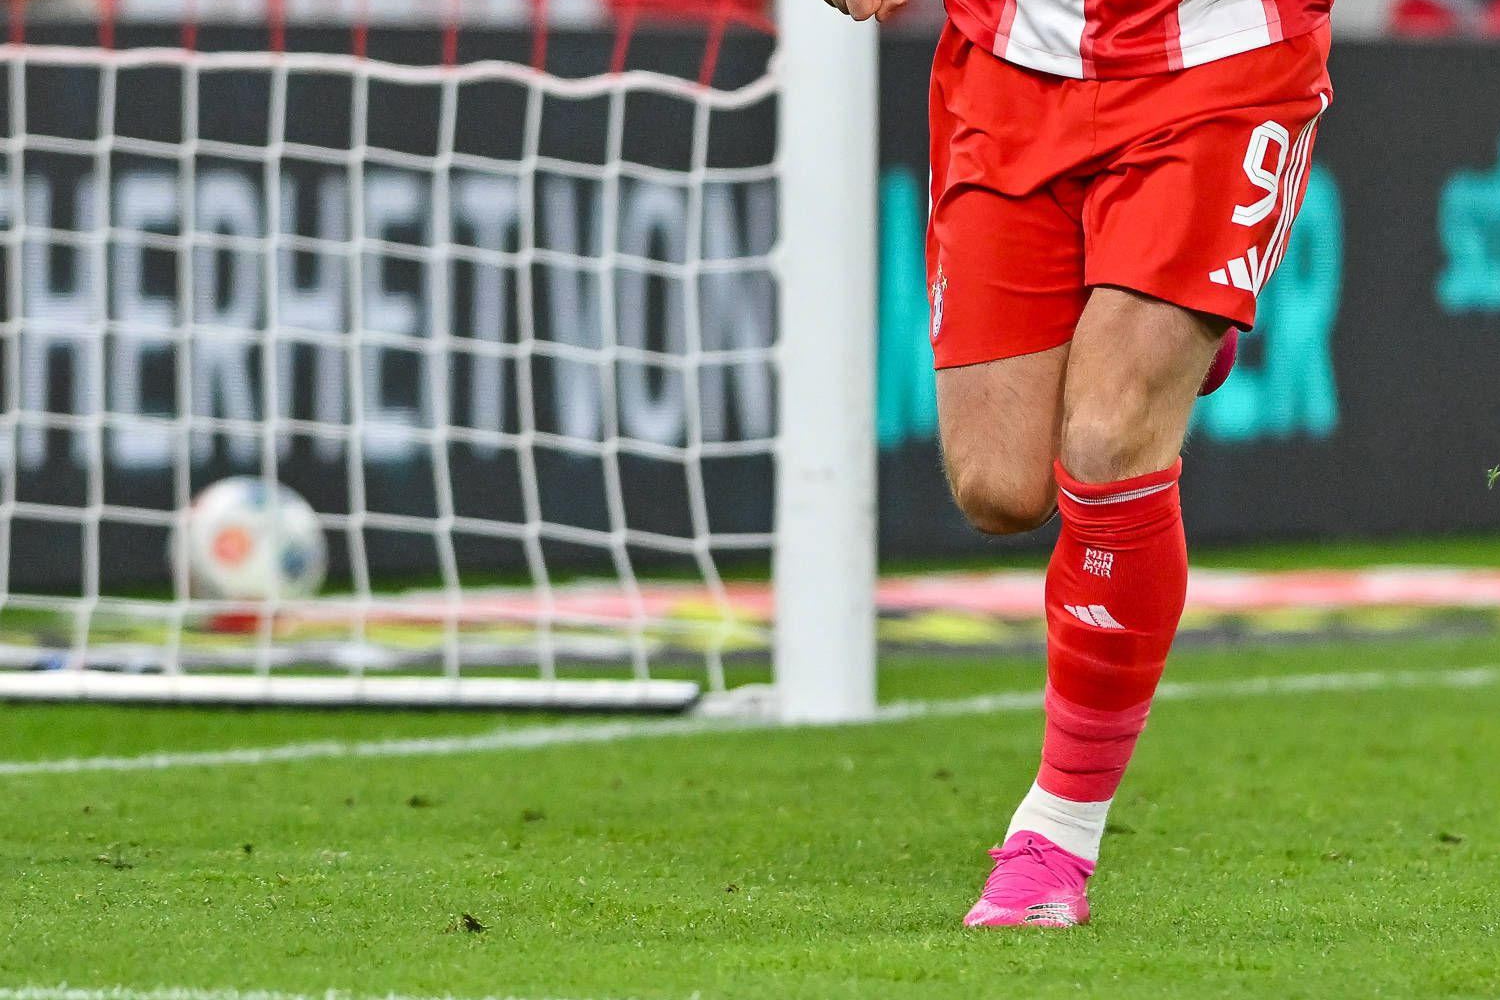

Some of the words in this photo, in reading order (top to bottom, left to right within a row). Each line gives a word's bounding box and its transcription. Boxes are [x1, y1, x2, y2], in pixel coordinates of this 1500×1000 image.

[1231, 119, 1290, 227] 9
[1085, 547, 1114, 562] MIA
[1083, 562, 1111, 579] MIR
